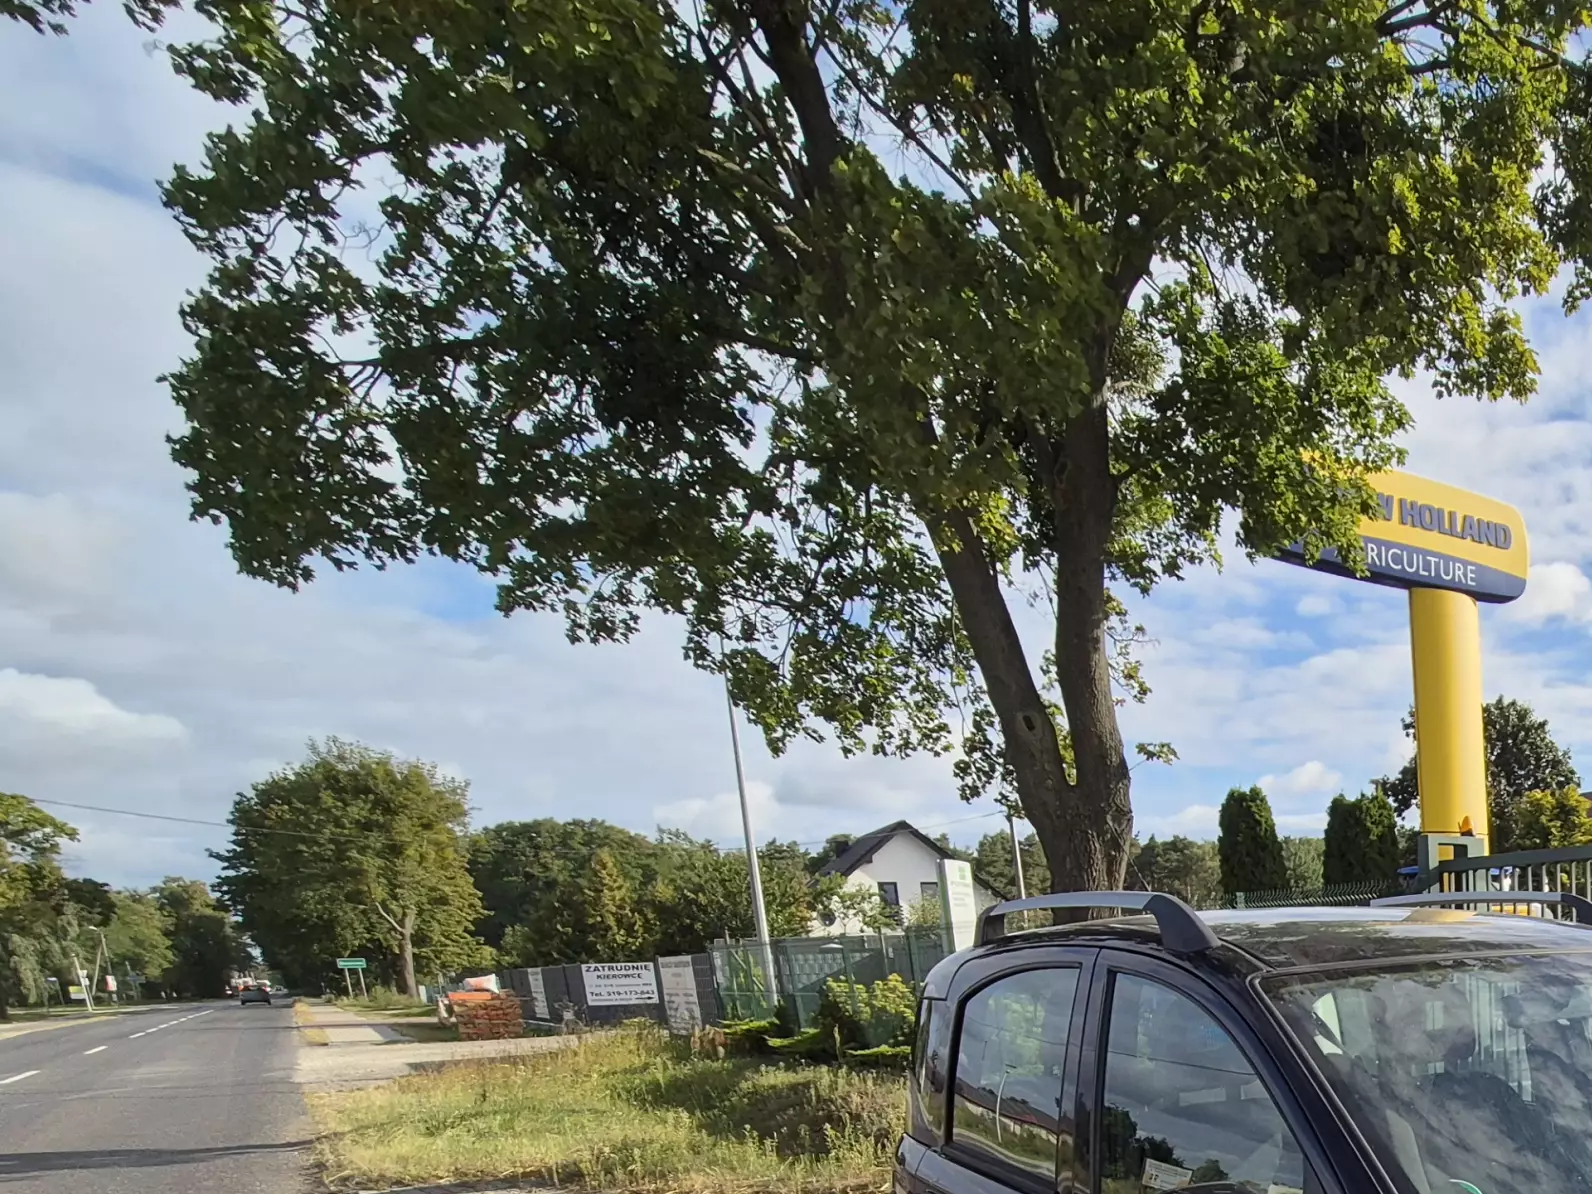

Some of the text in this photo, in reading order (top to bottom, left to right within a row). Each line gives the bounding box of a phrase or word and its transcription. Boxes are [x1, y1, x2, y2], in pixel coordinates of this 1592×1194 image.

[1398, 497, 1512, 550] HOLLAND
[1367, 543, 1476, 585] RICULTURE
[585, 964, 651, 972] ZATRUDNIĘ
